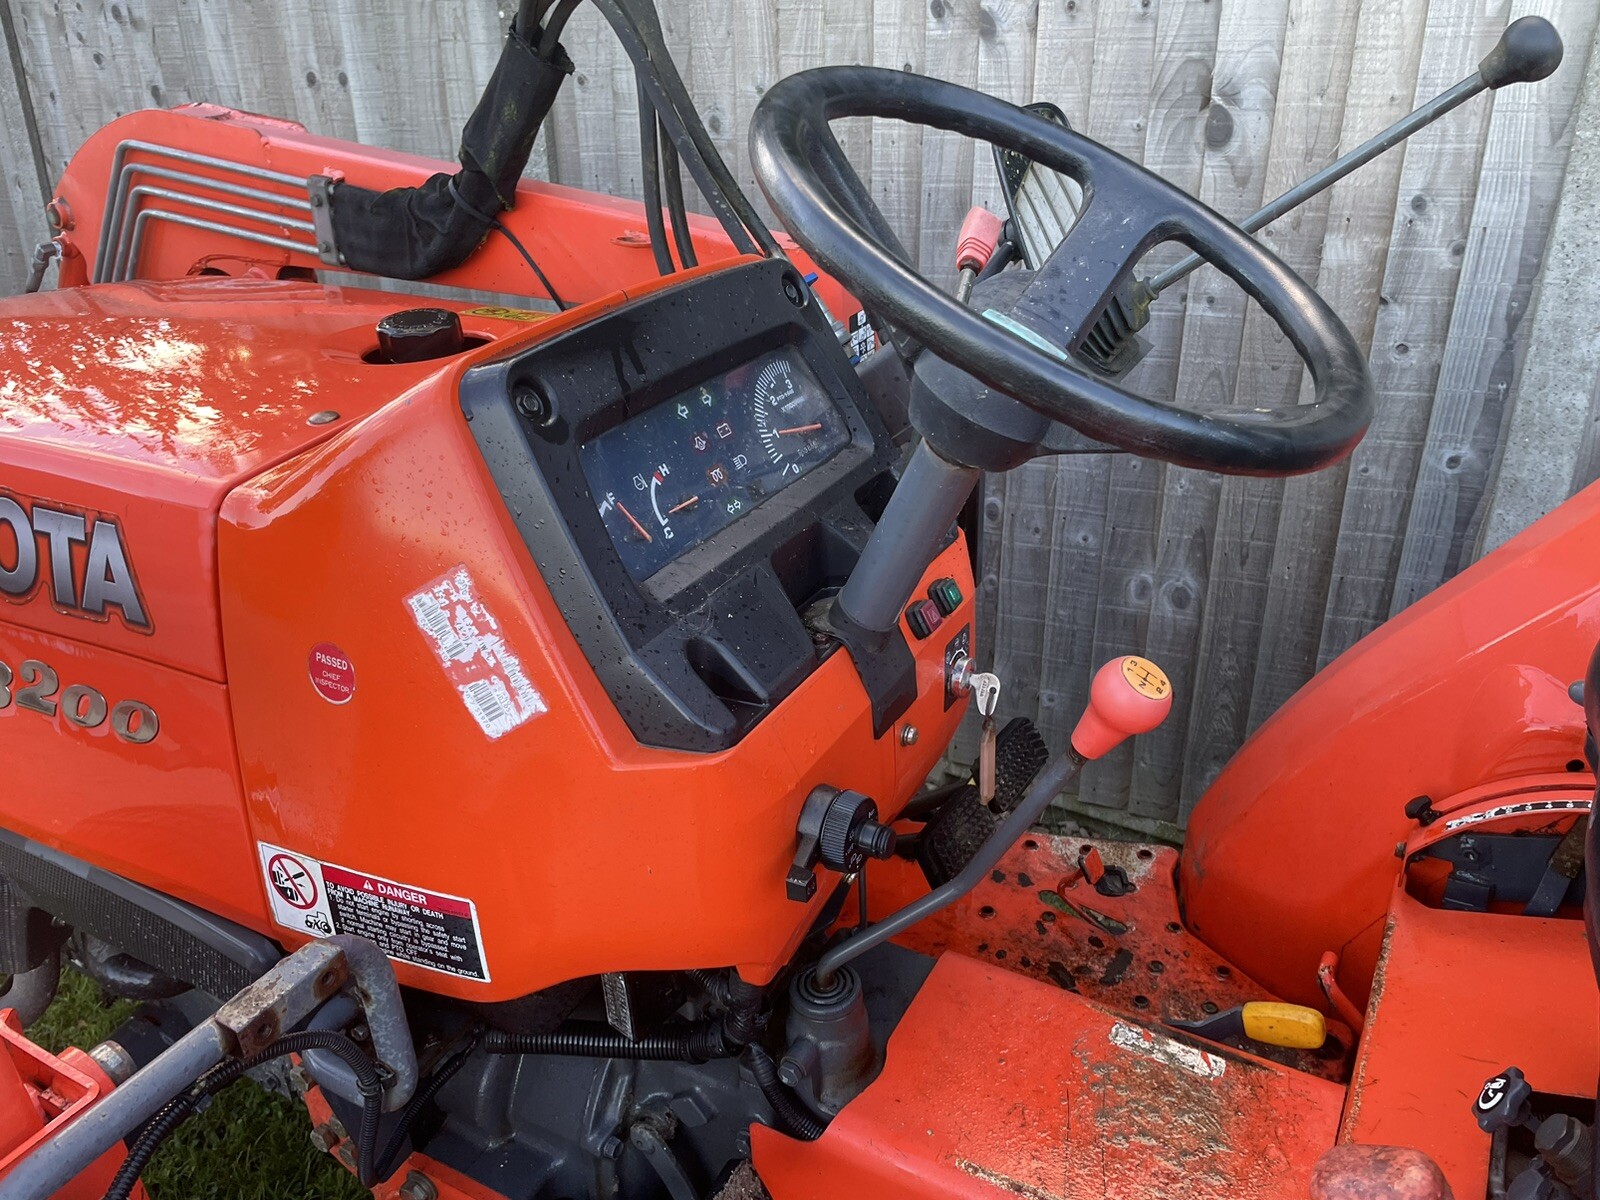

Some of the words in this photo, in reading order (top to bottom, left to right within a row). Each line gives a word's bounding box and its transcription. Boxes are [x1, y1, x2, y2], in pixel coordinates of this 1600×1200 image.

[658, 463, 670, 477] H
[315, 651, 348, 671] PASSED
[314, 676, 350, 694] INSPECTOR
[322, 670, 341, 681] CHIEF
[327, 888, 343, 897] FROM
[337, 884, 354, 894] AVOID
[387, 899, 407, 909] INJURY
[422, 908, 444, 919] DEATH
[377, 883, 427, 904] DANGER
[337, 904, 354, 913] starter
[390, 920, 418, 932] bypassing
[432, 930, 450, 941] safety
[452, 934, 466, 944] start
[346, 919, 365, 928] normal
[367, 925, 387, 936] starting
[371, 907, 390, 917] engine
[401, 916, 424, 927] shorting
[425, 922, 445, 932] across
[359, 916, 383, 927] Machine
[385, 924, 397, 932] may
[421, 934, 434, 943] gear
[450, 941, 467, 950] move
[356, 928, 375, 939] engine
[377, 934, 389, 943] only
[390, 938, 404, 946] from
[450, 953, 463, 962] with
[391, 944, 404, 952] PTO
[412, 955, 436, 967] standing
